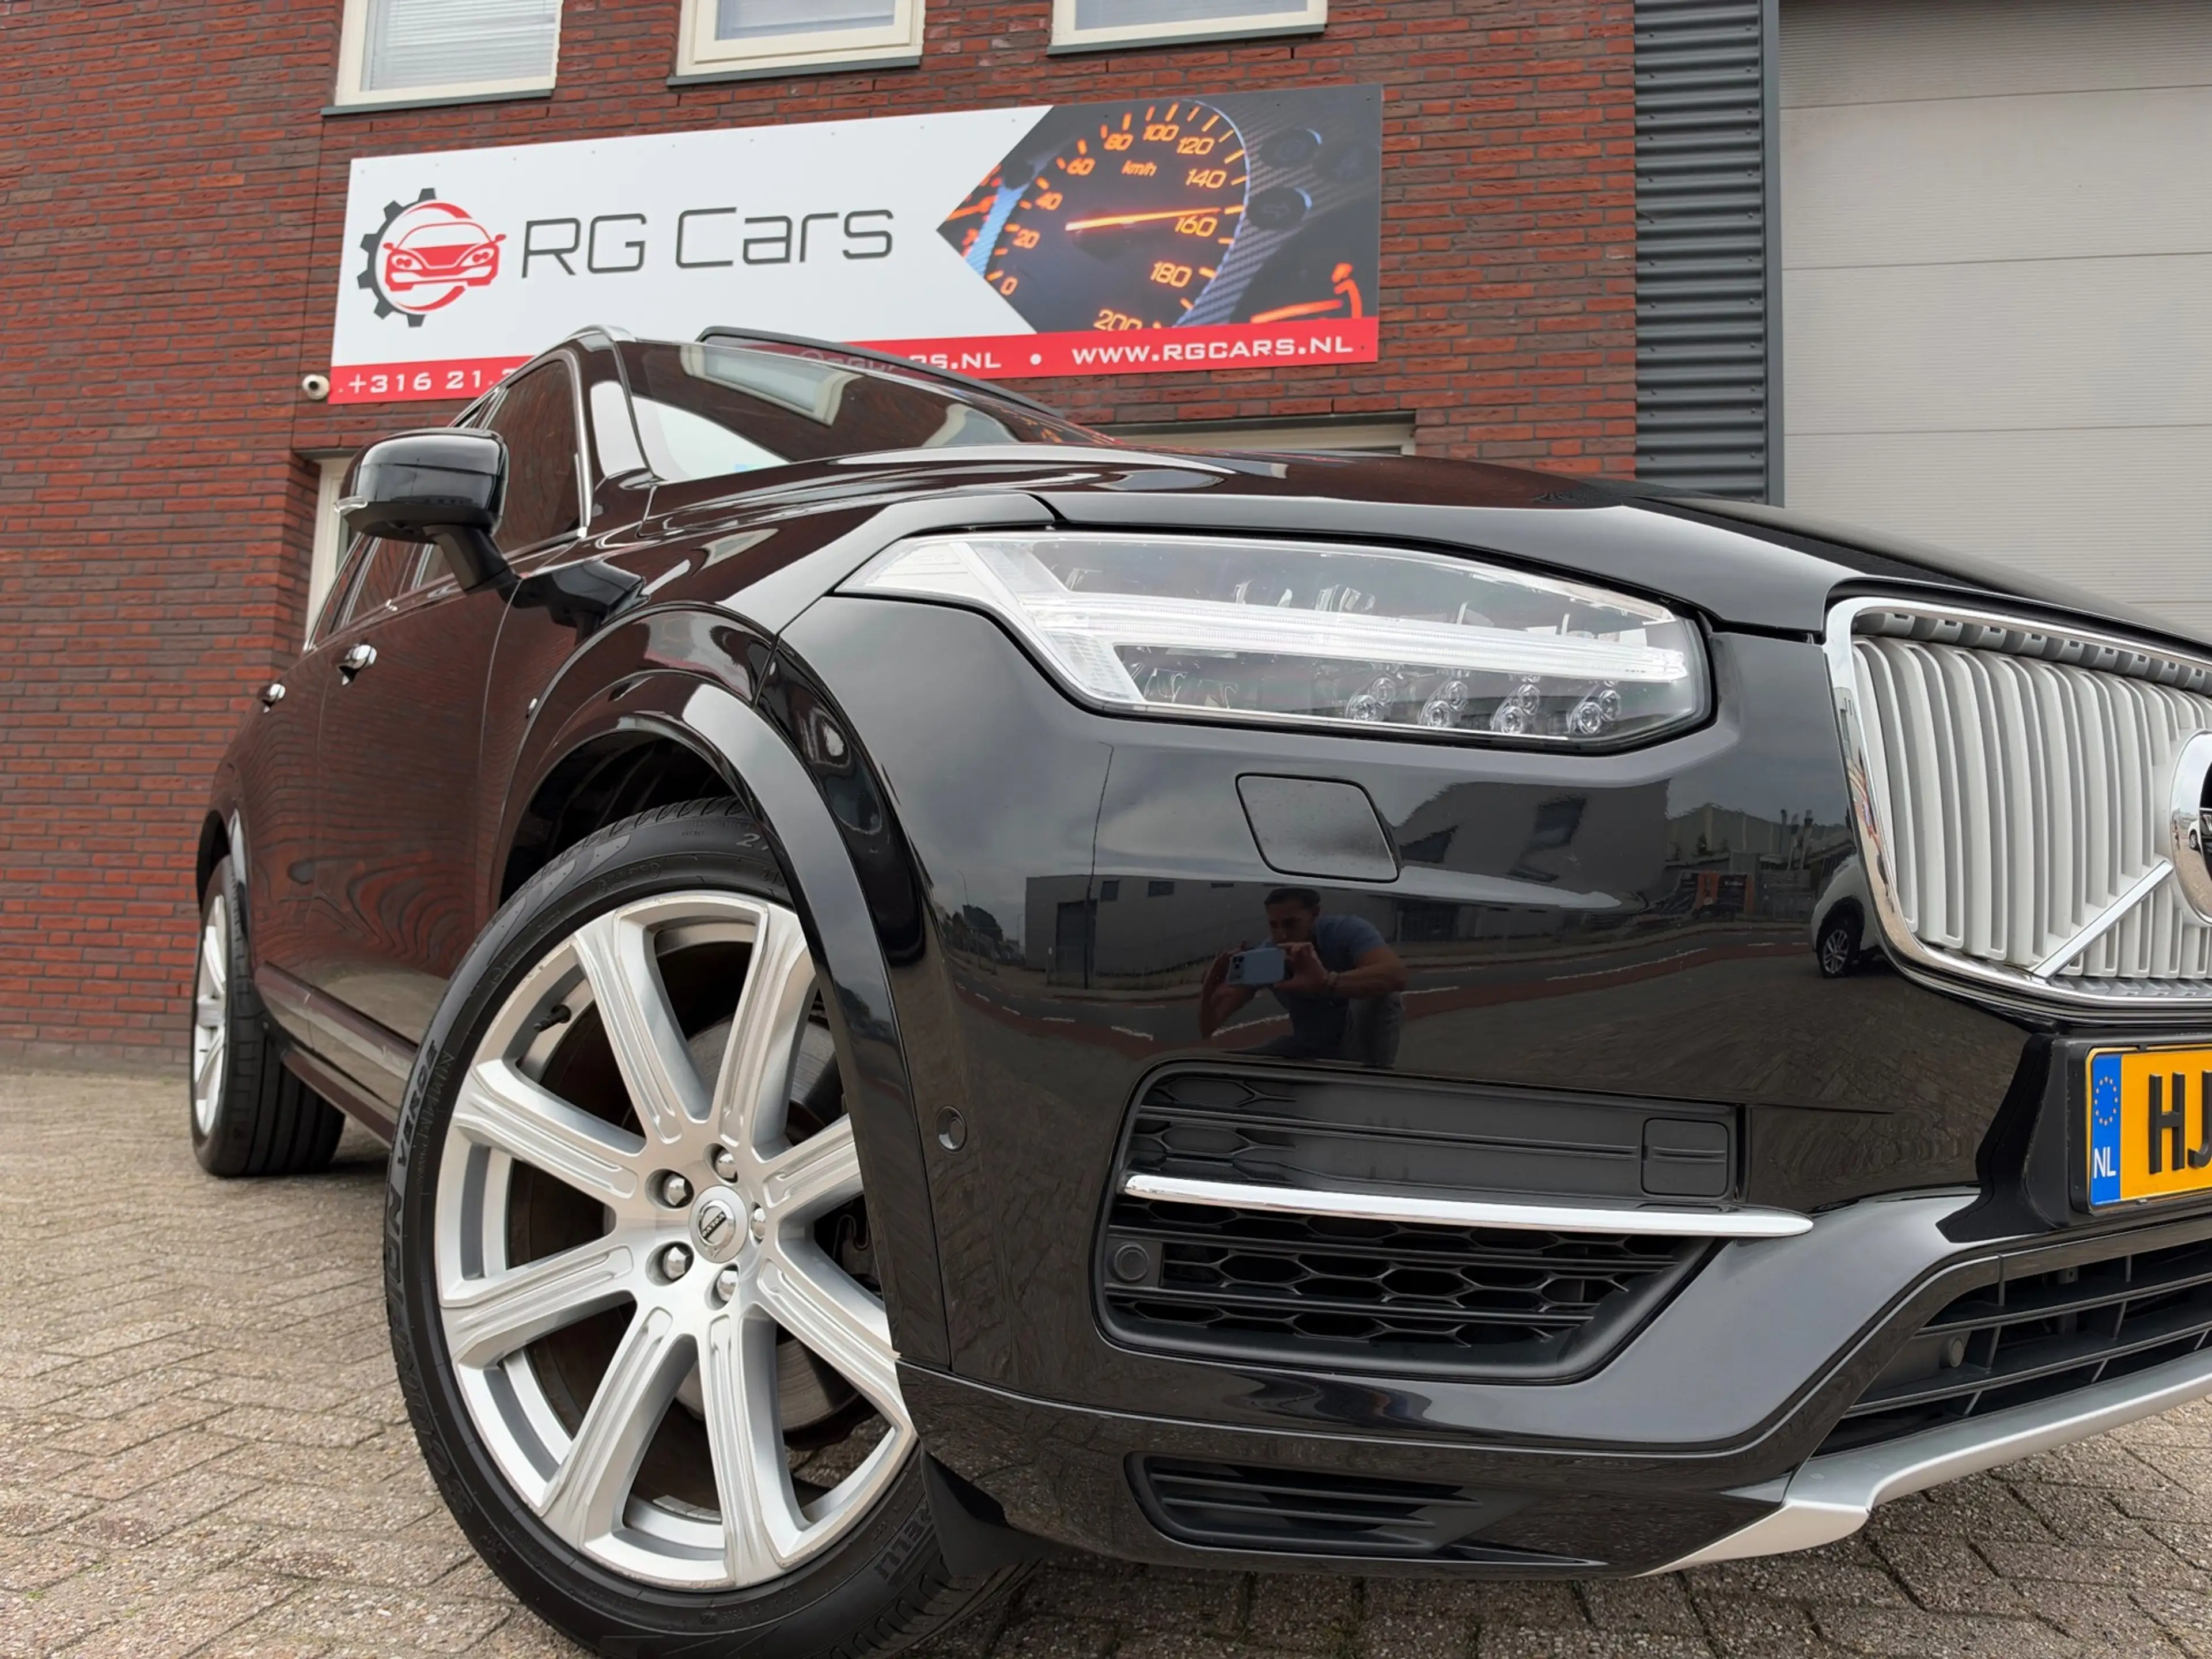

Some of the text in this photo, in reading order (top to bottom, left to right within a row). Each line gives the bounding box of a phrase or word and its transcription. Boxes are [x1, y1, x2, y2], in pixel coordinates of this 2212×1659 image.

[1104, 133, 1134, 150] 80
[1142, 124, 1179, 141] 100
[1176, 137, 1215, 155] 120
[1067, 158, 1095, 175] 60
[1185, 168, 1227, 189] 140
[1035, 191, 1063, 210] 40
[1175, 214, 1218, 237] 160
[521, 213, 647, 278] RG
[676, 207, 894, 269] Cars
[1012, 228, 1040, 249] 20
[1150, 261, 1192, 288] 180
[1071, 336, 1354, 365] WWW.RGCARS.NL
[348, 372, 432, 394] +316
[2093, 1146, 2116, 1179] NL
